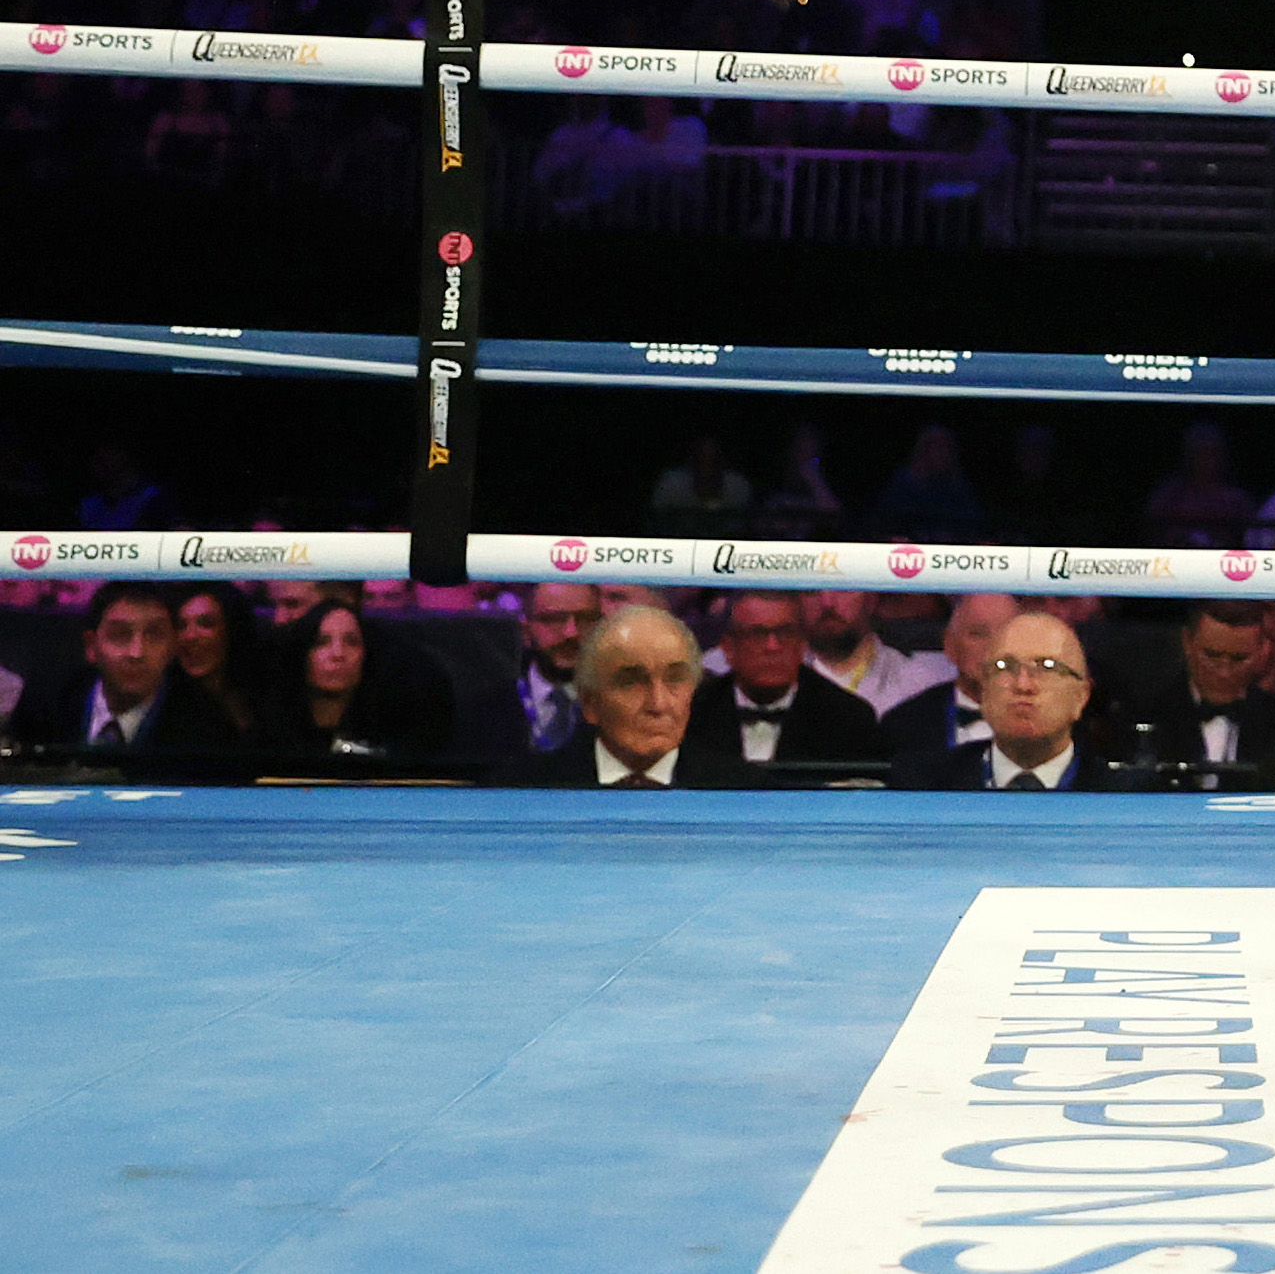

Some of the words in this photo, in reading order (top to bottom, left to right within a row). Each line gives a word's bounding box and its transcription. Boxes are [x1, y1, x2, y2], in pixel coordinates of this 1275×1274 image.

[72, 32, 153, 51] SPORTS
[192, 30, 299, 63] QUEENSBERRY
[599, 54, 677, 73] SPORTS
[716, 52, 817, 84] QUEENSBERRY
[930, 67, 1008, 87] SPORTS
[1046, 66, 1149, 96] QUEENSBERRY
[441, 266, 461, 331] SPORTS
[57, 543, 139, 561] SPORTS
[180, 535, 288, 568] QUEENSBERRY
[594, 546, 674, 565] SPORTS
[713, 543, 819, 574] QUEENSBERRY
[931, 554, 1009, 571] SPORTS
[1048, 549, 1151, 580] QUEENSBERRY
[1010, 929, 1251, 1005] PLAY
